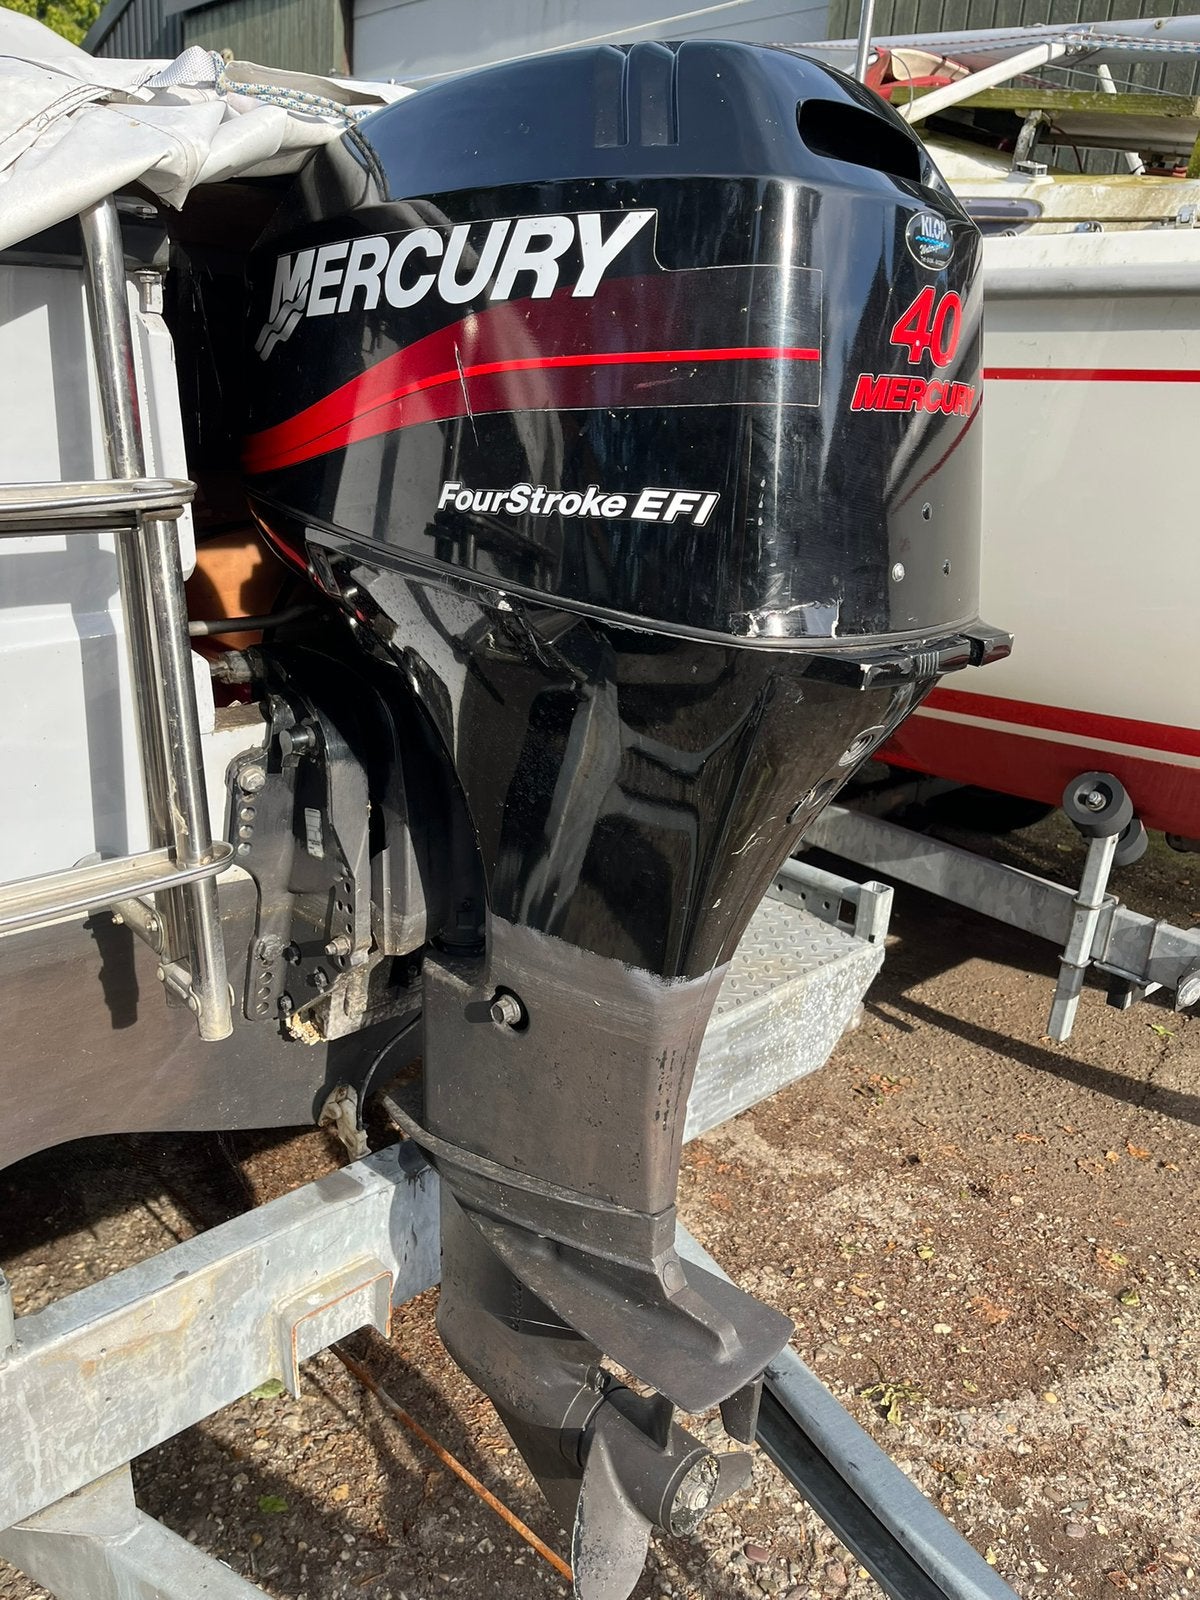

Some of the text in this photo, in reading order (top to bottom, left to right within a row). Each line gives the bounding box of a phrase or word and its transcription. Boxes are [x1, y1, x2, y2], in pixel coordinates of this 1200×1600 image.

[920, 214, 947, 241] KLOP
[268, 209, 657, 324] MERCURY
[890, 285, 962, 368] 40
[851, 373, 975, 416] MERCURY
[436, 481, 718, 526] FourStroke EFI
